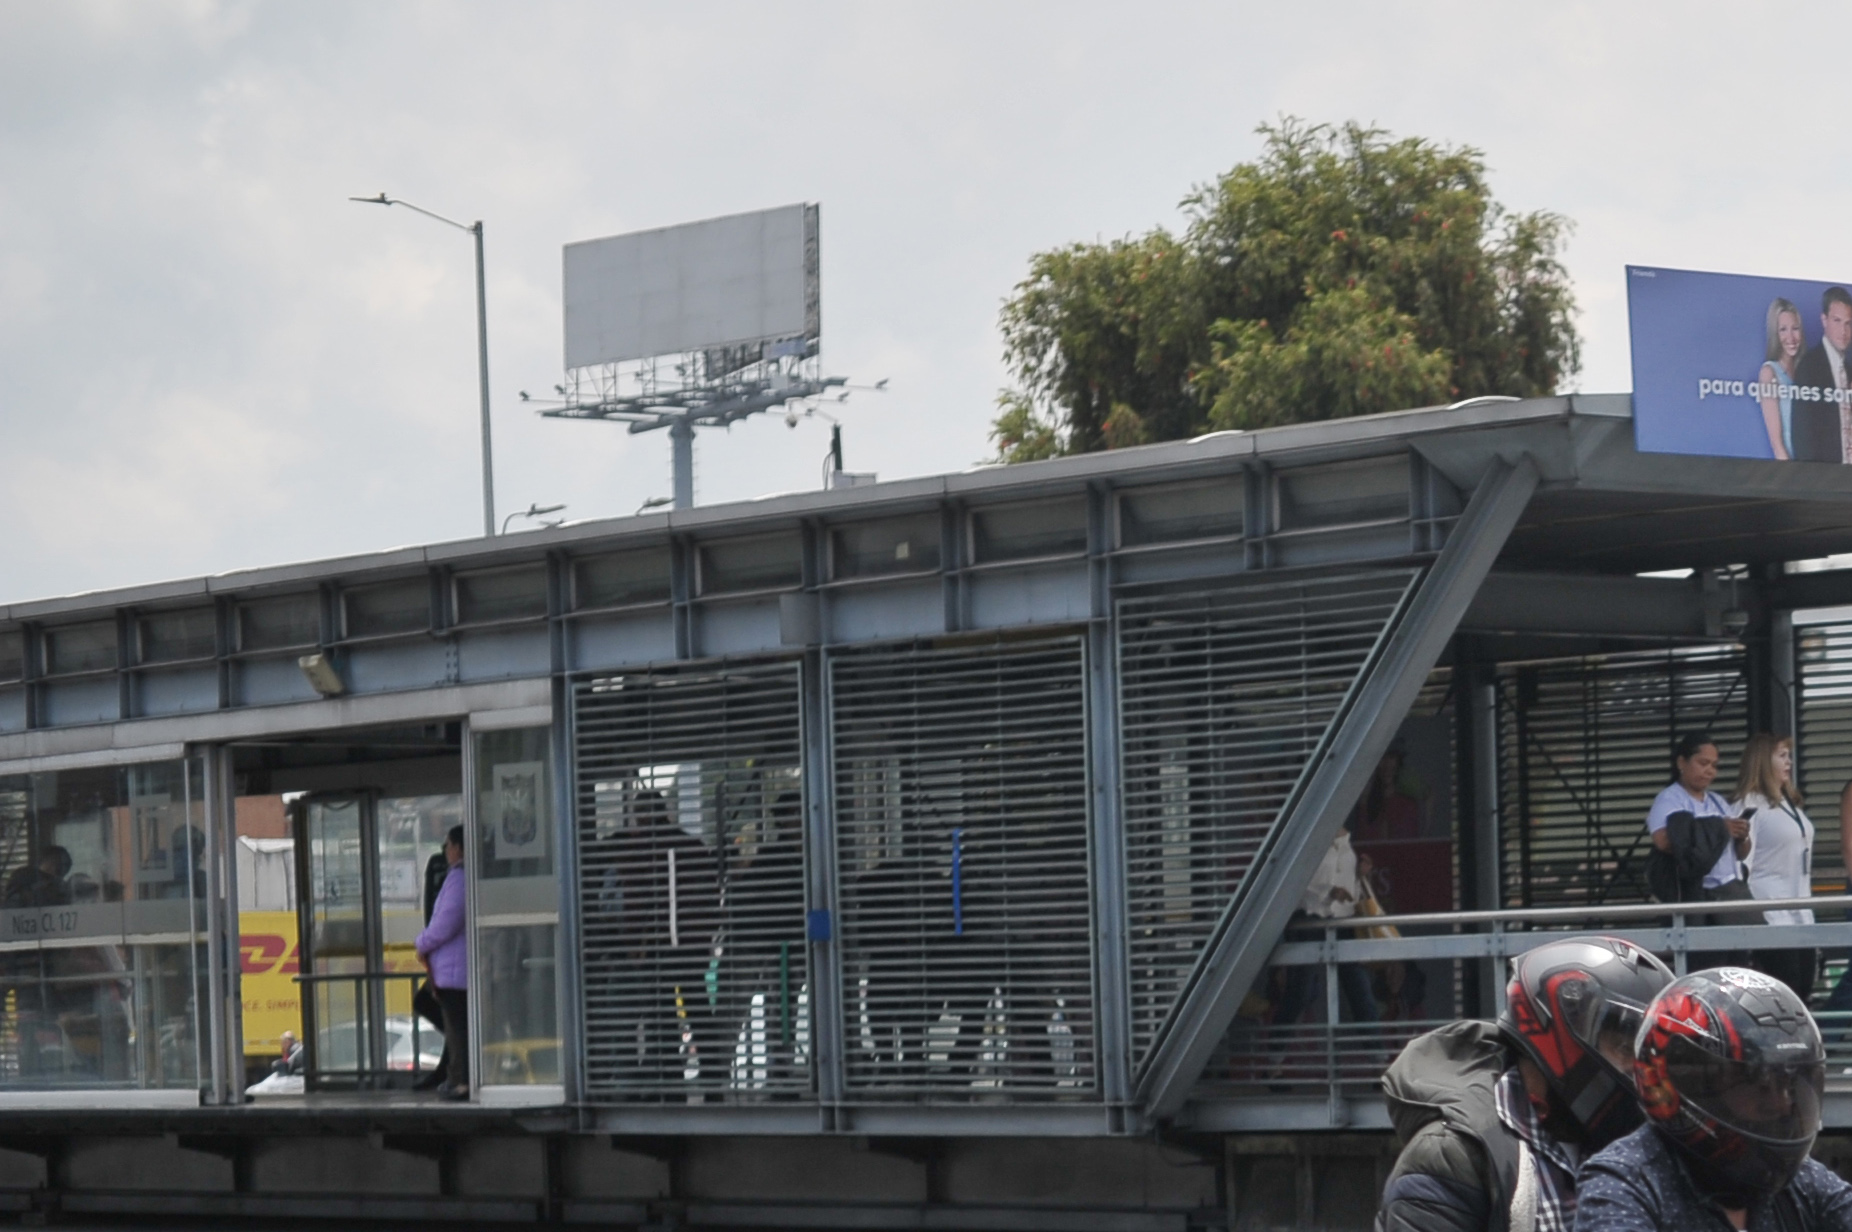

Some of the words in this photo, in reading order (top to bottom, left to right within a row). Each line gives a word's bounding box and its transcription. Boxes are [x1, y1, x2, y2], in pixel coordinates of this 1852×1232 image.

[1698, 377, 1744, 399] para
[1747, 378, 1821, 403] quienes
[12, 914, 37, 935] Niza
[58, 911, 79, 932] 127
